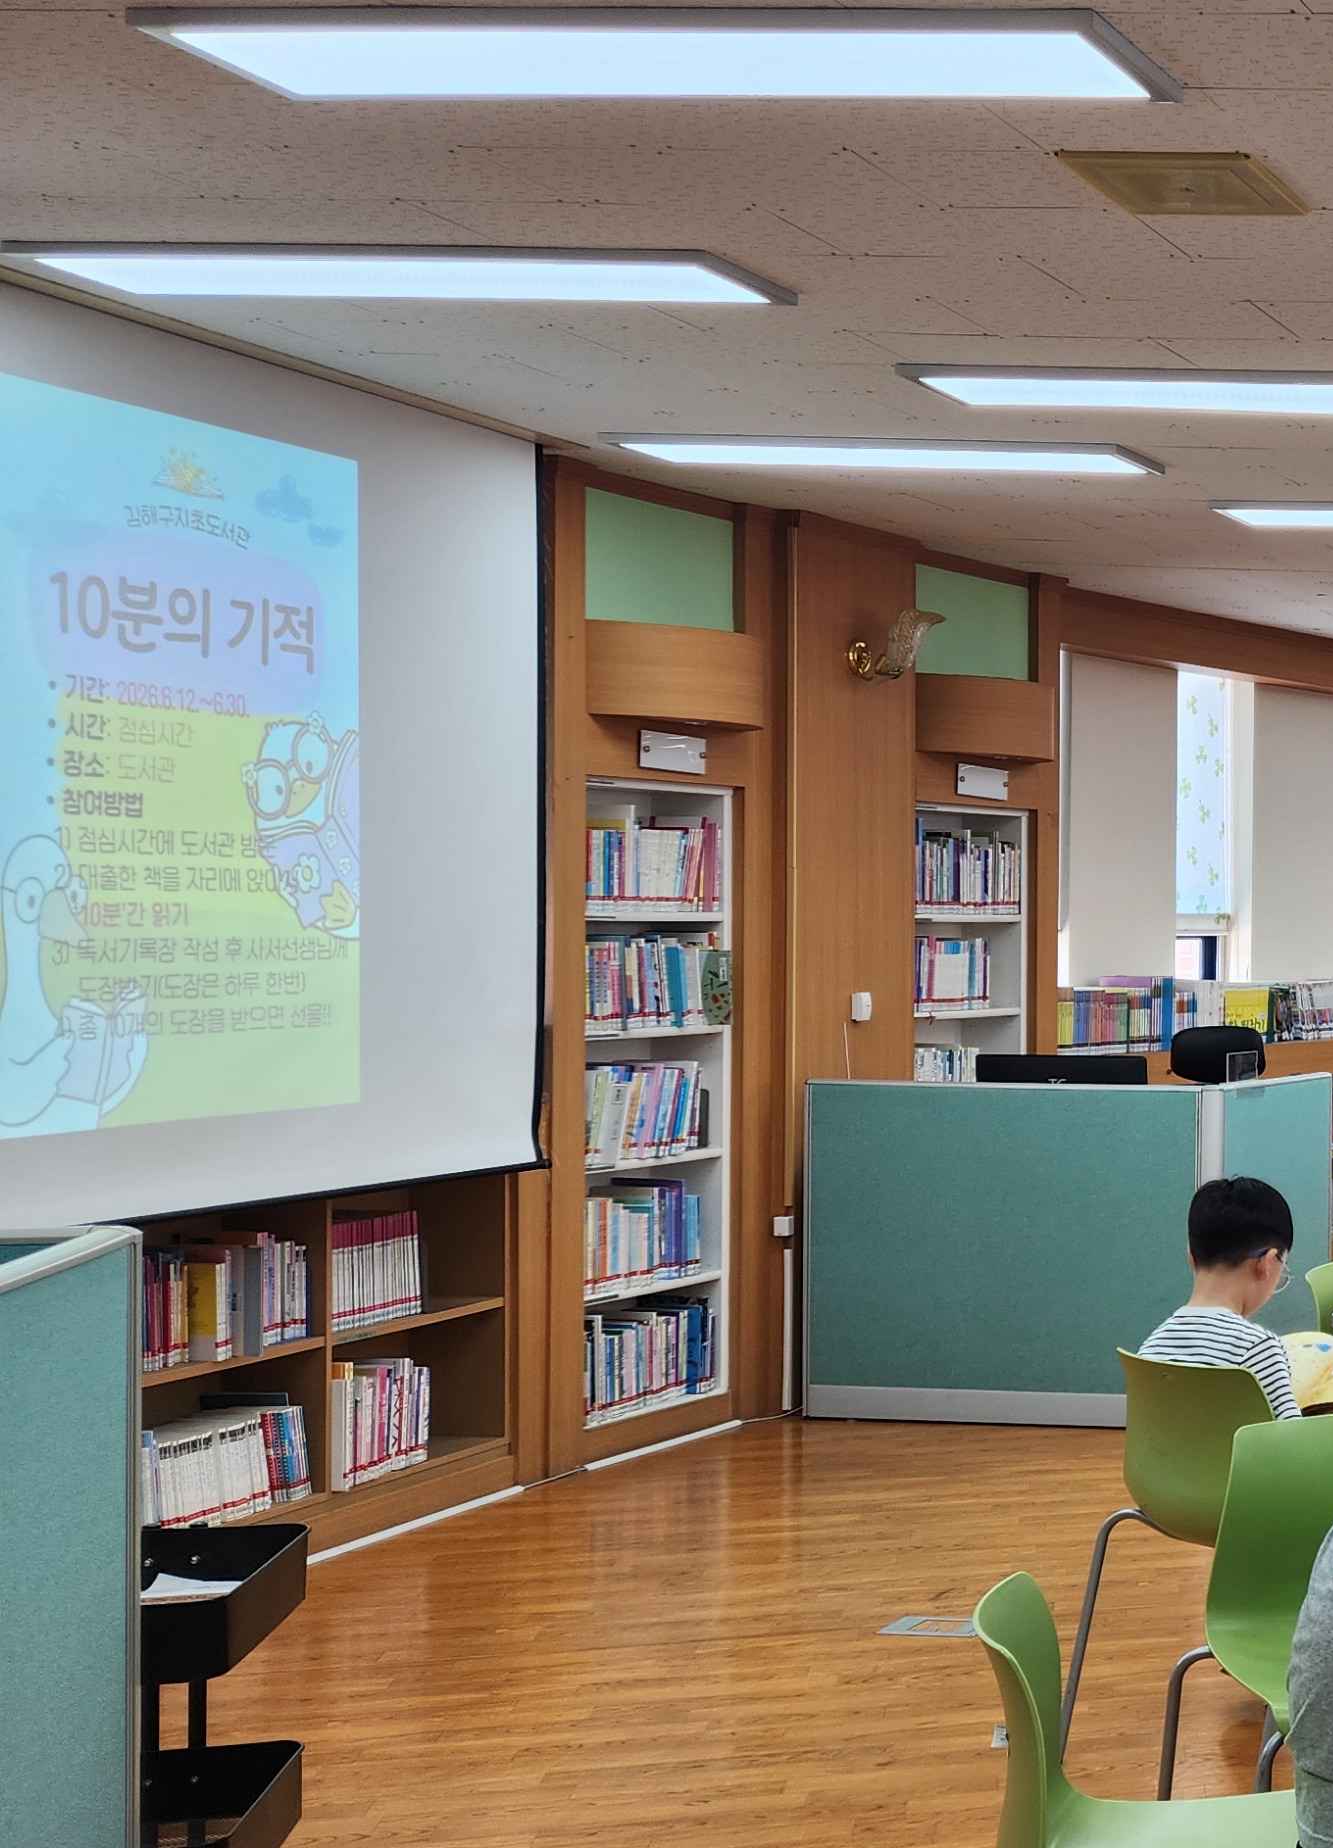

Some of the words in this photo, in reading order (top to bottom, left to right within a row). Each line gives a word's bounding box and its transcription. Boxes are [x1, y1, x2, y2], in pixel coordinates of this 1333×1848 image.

[123, 505, 251, 549] 김해구지초도서관
[50, 571, 211, 658] 10분의
[227, 598, 314, 675] 기적
[65, 673, 110, 704] 기간:
[64, 712, 111, 741] 시간:
[117, 716, 194, 748] 점심시간
[63, 750, 110, 778] 장소:
[117, 753, 176, 784] 도서관
[62, 788, 144, 818] 참여방법
[78, 827, 174, 856] 점심시간에
[180, 830, 235, 858] 도서관
[78, 863, 137, 892] 대출한
[142, 864, 181, 893] 책을
[186, 866, 241, 893] 자리에
[152, 902, 189, 928] 읽기
[77, 936, 177, 965] 독서기록장
[183, 937, 219, 963] 작성
[224, 936, 243, 962] 후
[247, 936, 348, 962] 사서선생님께
[225, 971, 261, 997] 하루
[170, 1007, 225, 1036] 도장을
[230, 1004, 285, 1031] 받으면
